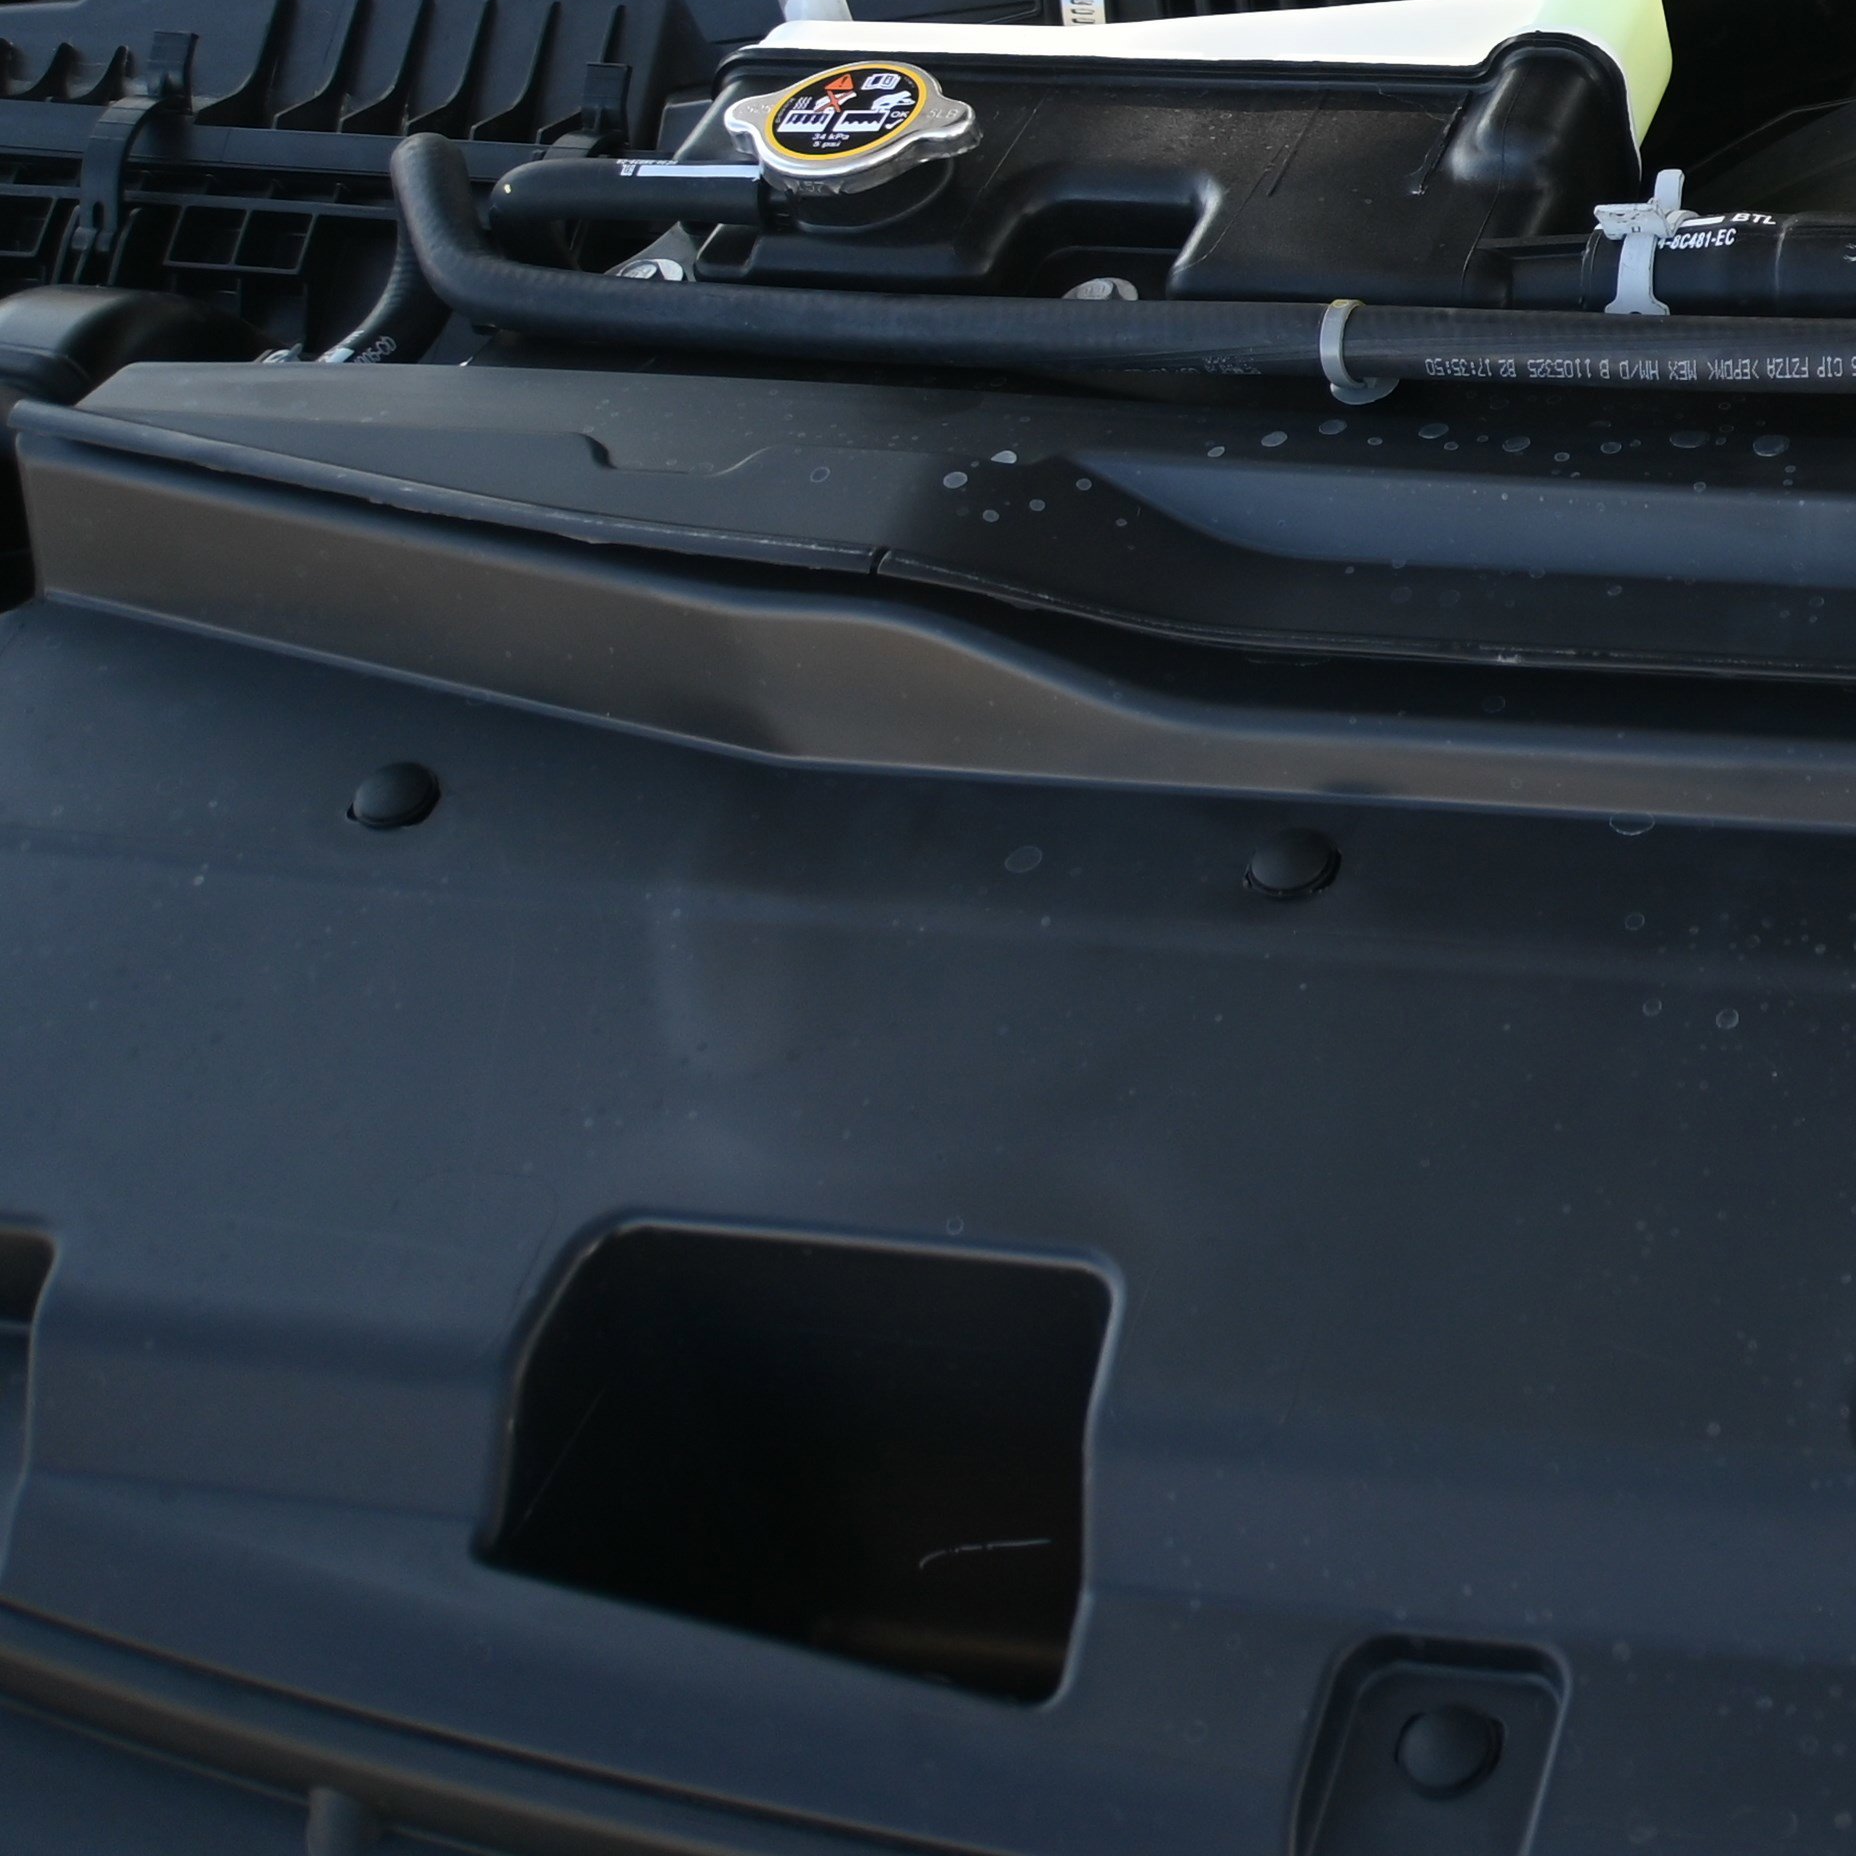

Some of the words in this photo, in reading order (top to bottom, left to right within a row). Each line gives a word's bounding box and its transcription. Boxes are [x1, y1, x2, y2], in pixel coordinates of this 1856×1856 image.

[890, 110, 909, 119] OK
[812, 132, 827, 141] 34
[828, 132, 850, 141] kPa
[813, 140, 821, 148] 5
[822, 140, 842, 149] psi
[1731, 212, 1777, 225] BTL
[1424, 357, 1493, 378] 17:35:50
[1499, 360, 1517, 379] B2
[1528, 358, 1593, 380] 1105325
[1600, 360, 1611, 380] B
[1619, 359, 1661, 382] HM/D
[1669, 359, 1699, 382] MEX
[1816, 355, 1844, 378] CIP
